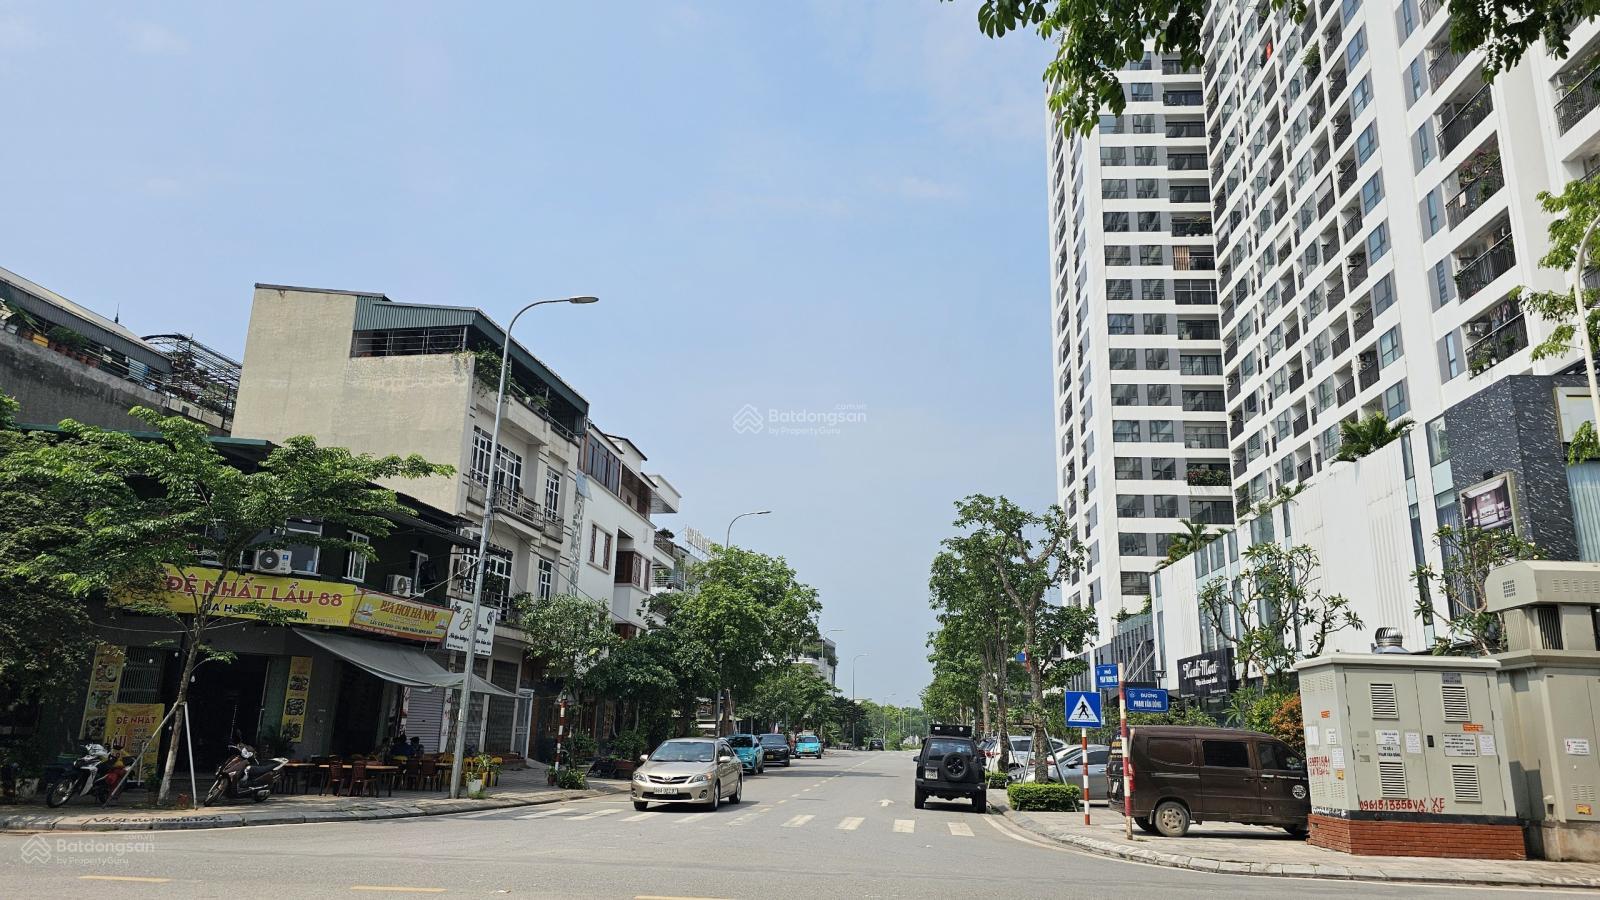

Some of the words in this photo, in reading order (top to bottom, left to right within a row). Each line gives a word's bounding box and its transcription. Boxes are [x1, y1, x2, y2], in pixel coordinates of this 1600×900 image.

[166, 573, 198, 596] ĐỆ
[203, 576, 266, 599] NHẤT
[272, 581, 313, 604] LẨU
[318, 592, 343, 607] 88
